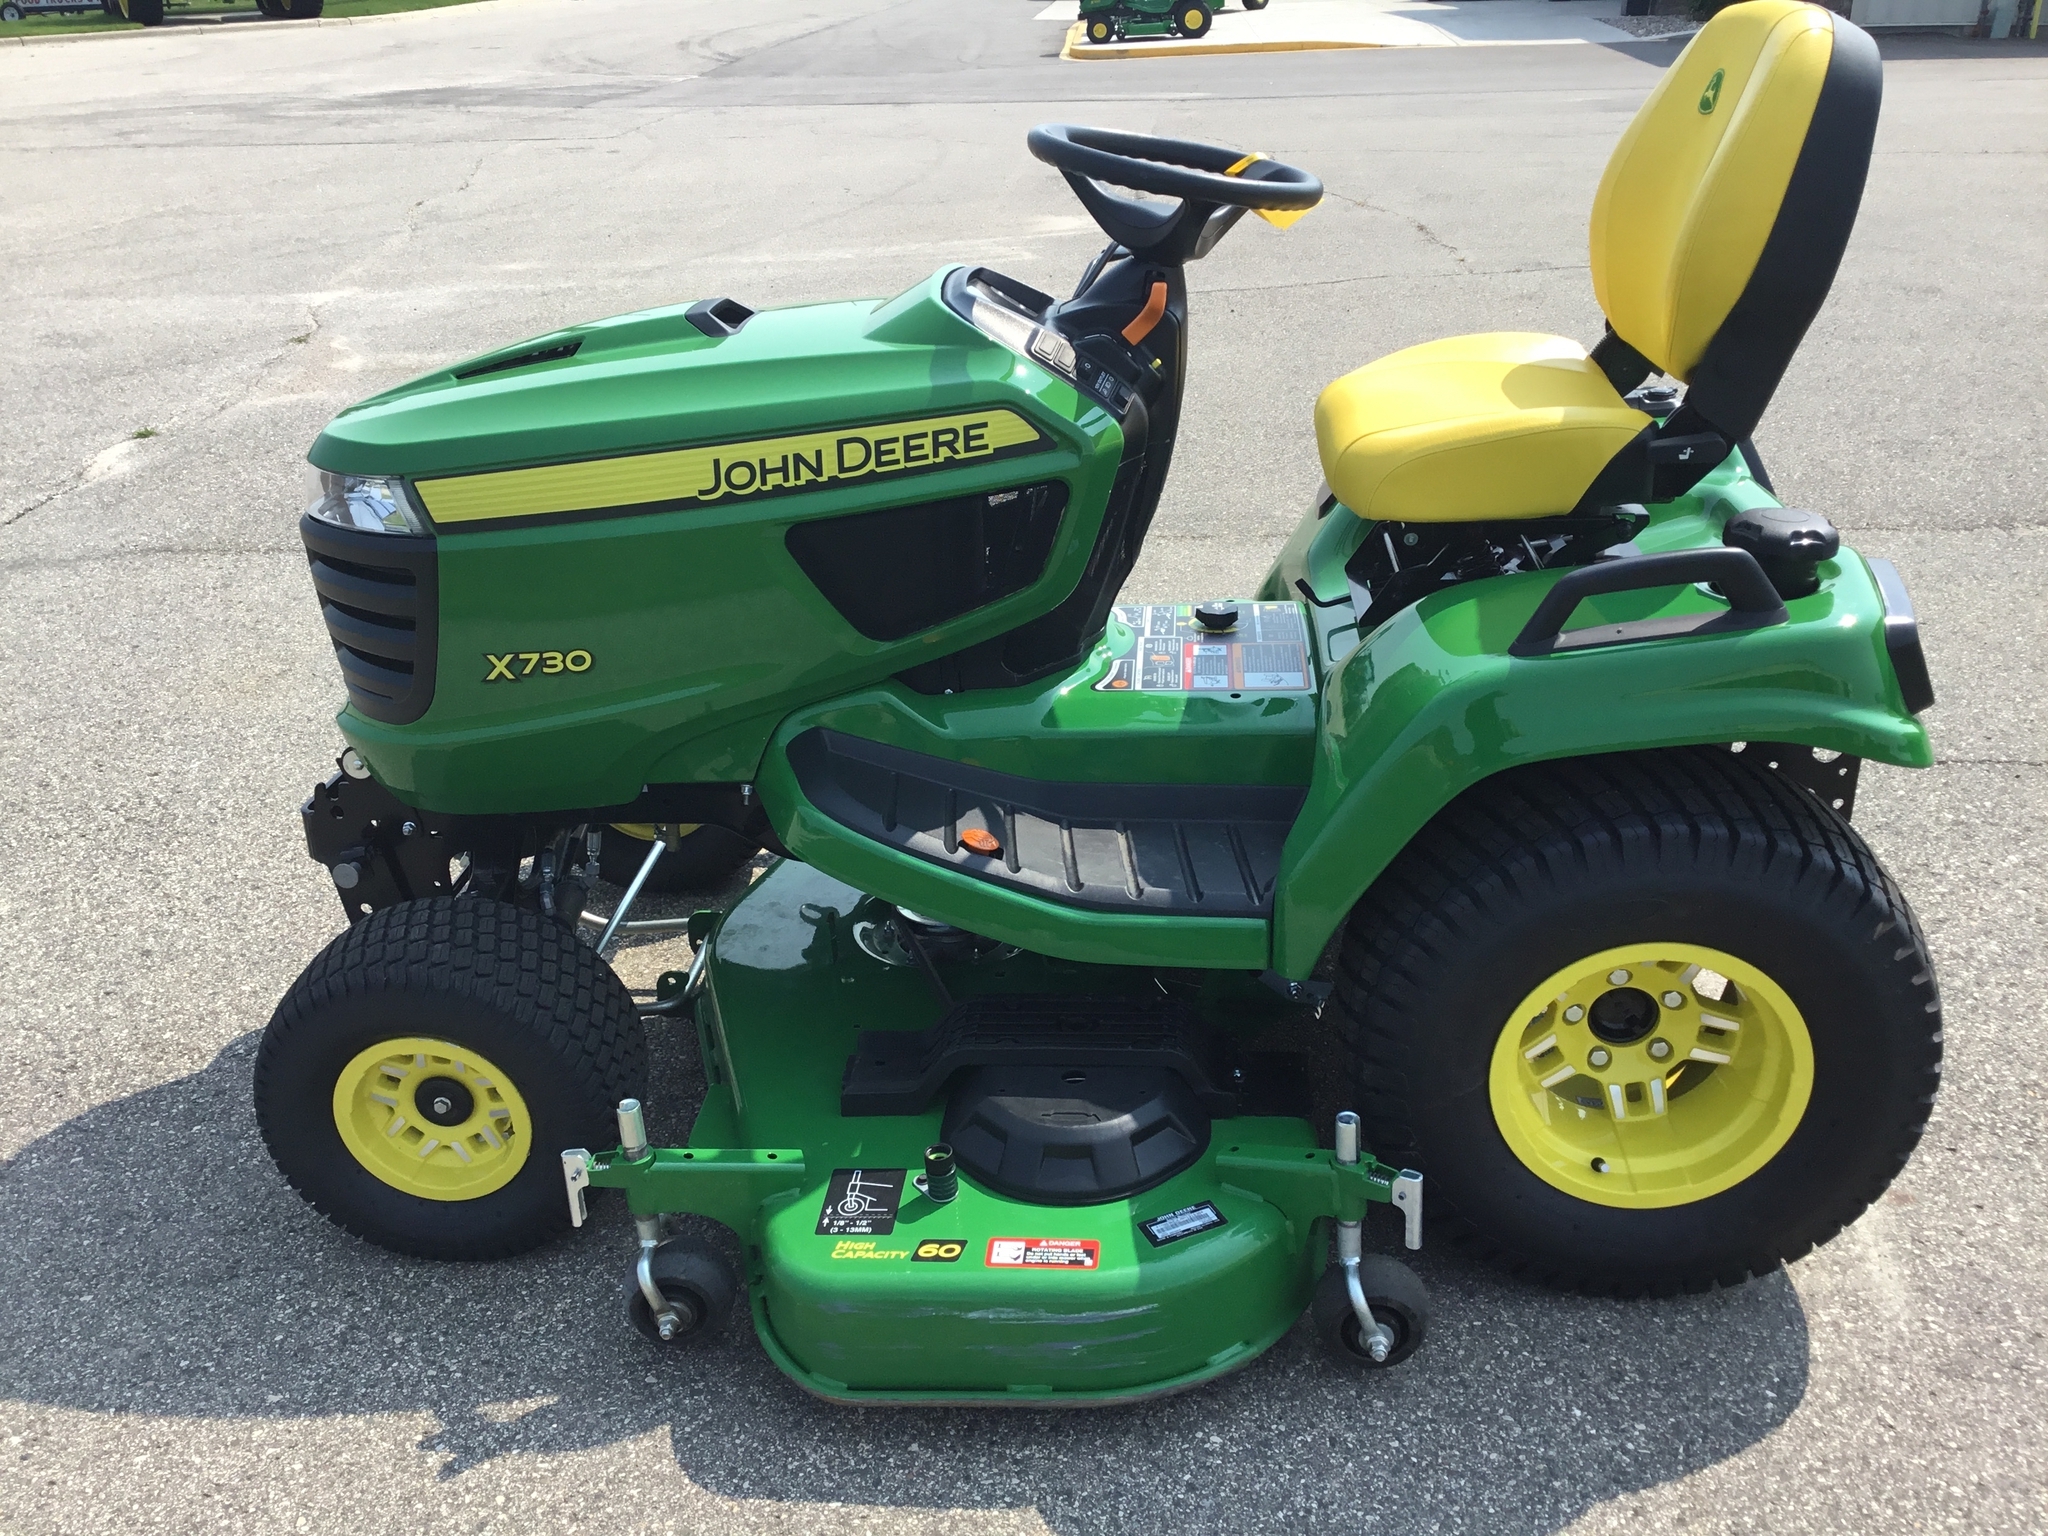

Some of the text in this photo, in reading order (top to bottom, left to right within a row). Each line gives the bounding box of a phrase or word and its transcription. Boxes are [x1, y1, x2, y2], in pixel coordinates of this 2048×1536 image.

[698, 421, 989, 497] JOHN DEERE
[485, 649, 592, 681] X730
[835, 1240, 876, 1250] HIGH
[917, 1243, 962, 1258] 60
[831, 1249, 910, 1259] CAPACITY
